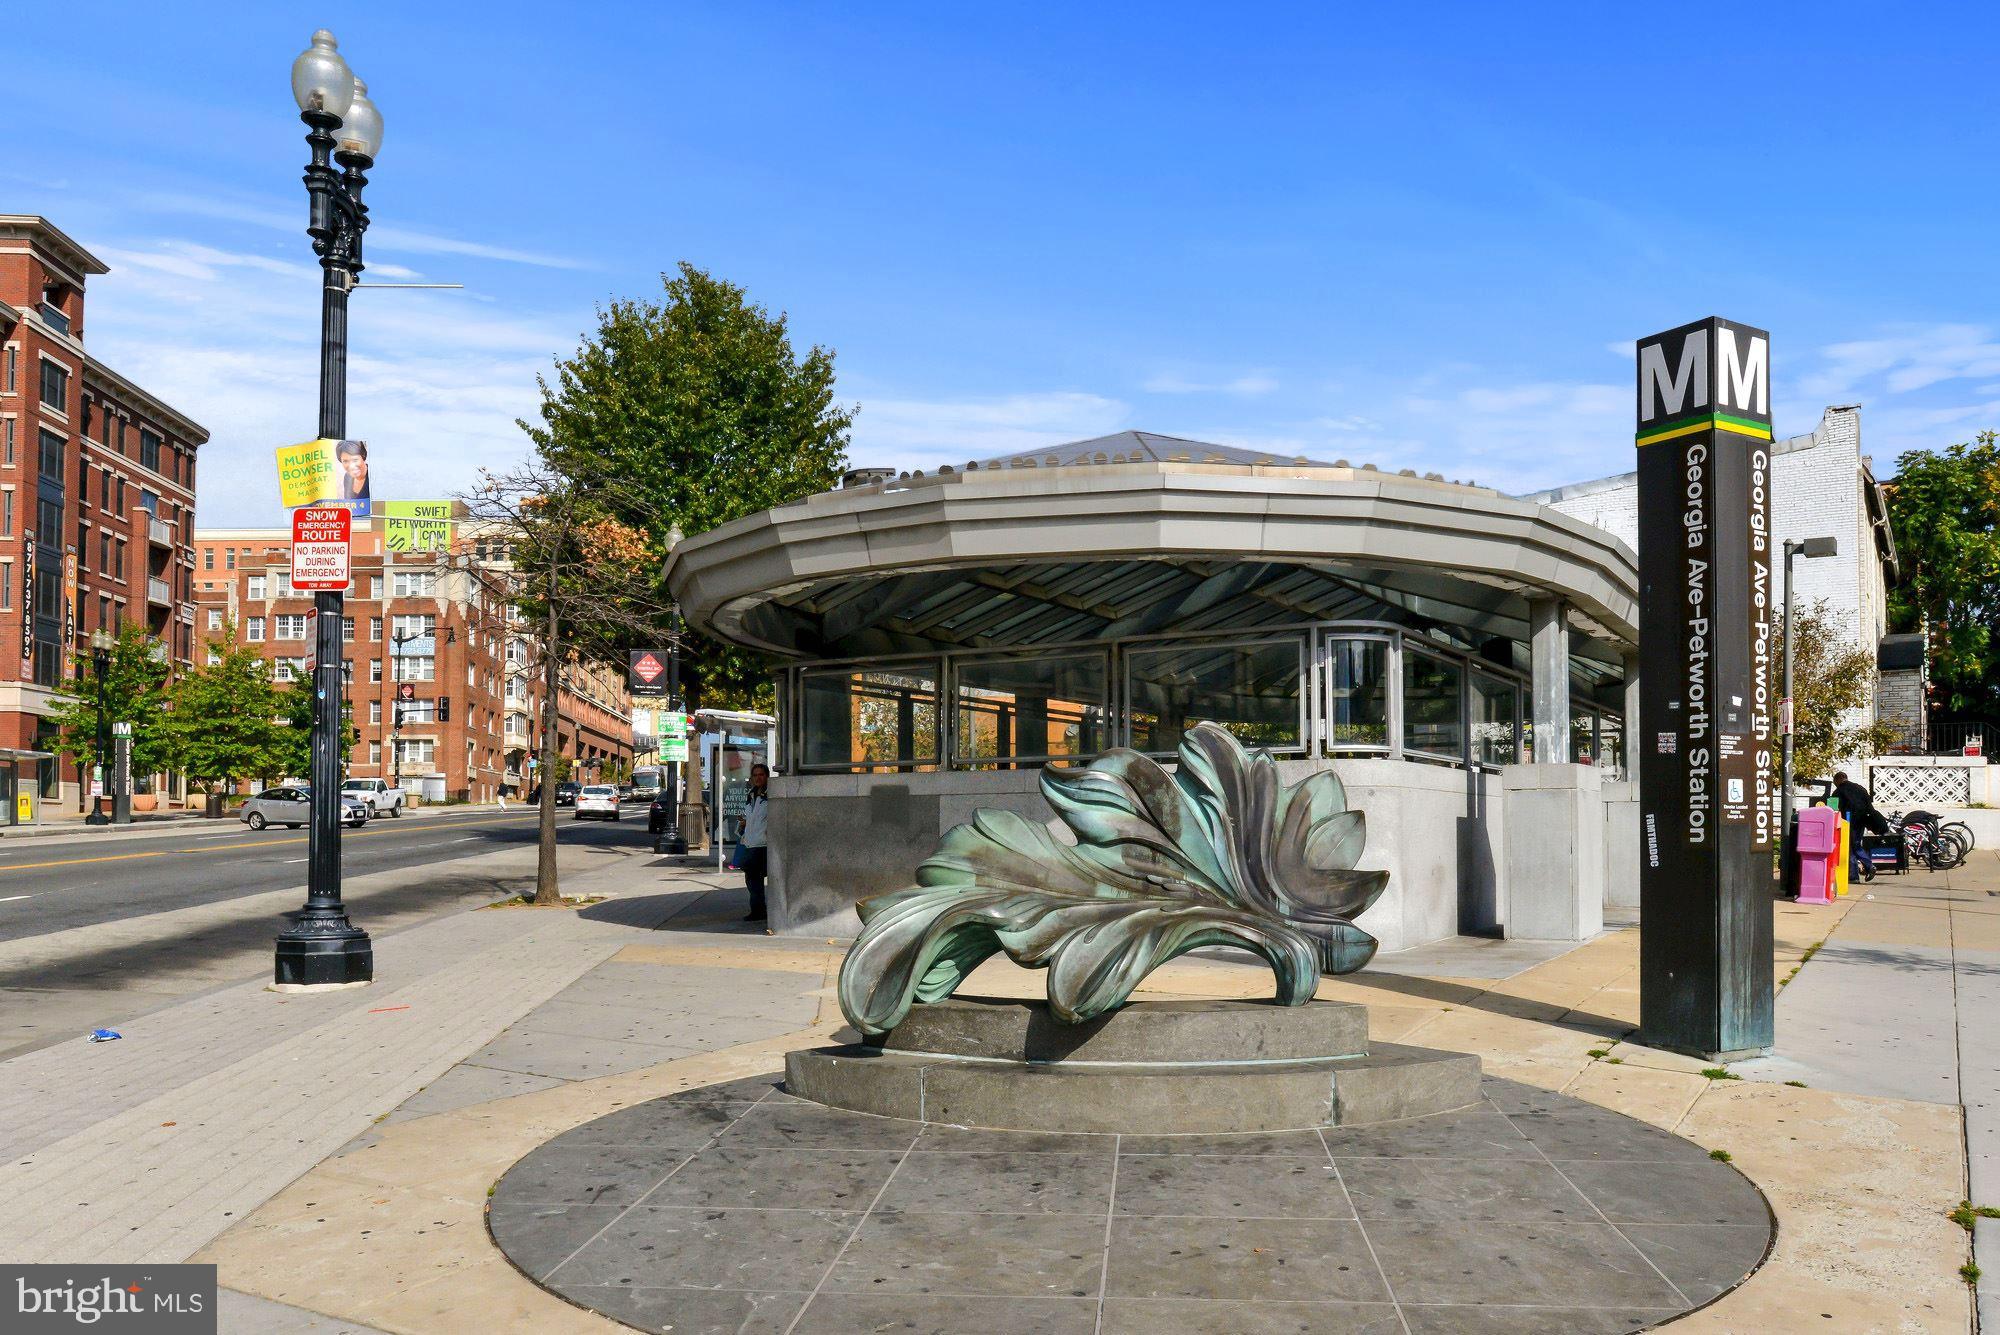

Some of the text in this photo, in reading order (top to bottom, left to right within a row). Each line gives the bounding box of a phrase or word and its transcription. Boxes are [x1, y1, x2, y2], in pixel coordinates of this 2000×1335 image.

[1641, 329, 1707, 422] M
[1718, 327, 1766, 415] M
[284, 450, 328, 467] MURIEL
[282, 462, 333, 480] BOWSER
[1684, 444, 1708, 548] Georgia
[1750, 450, 1768, 552] Georgia
[305, 511, 339, 521] SNOW
[414, 506, 447, 517] SWIFT
[389, 519, 446, 529] PETWORTH
[301, 531, 341, 541] ROUTE
[296, 547, 346, 555] NO PARKING
[305, 558, 336, 566] DURING
[66, 558, 76, 588] NOW
[296, 569, 346, 577] EMERGENCY
[1689, 748, 1710, 843] Station
[1756, 750, 1771, 844] Station
